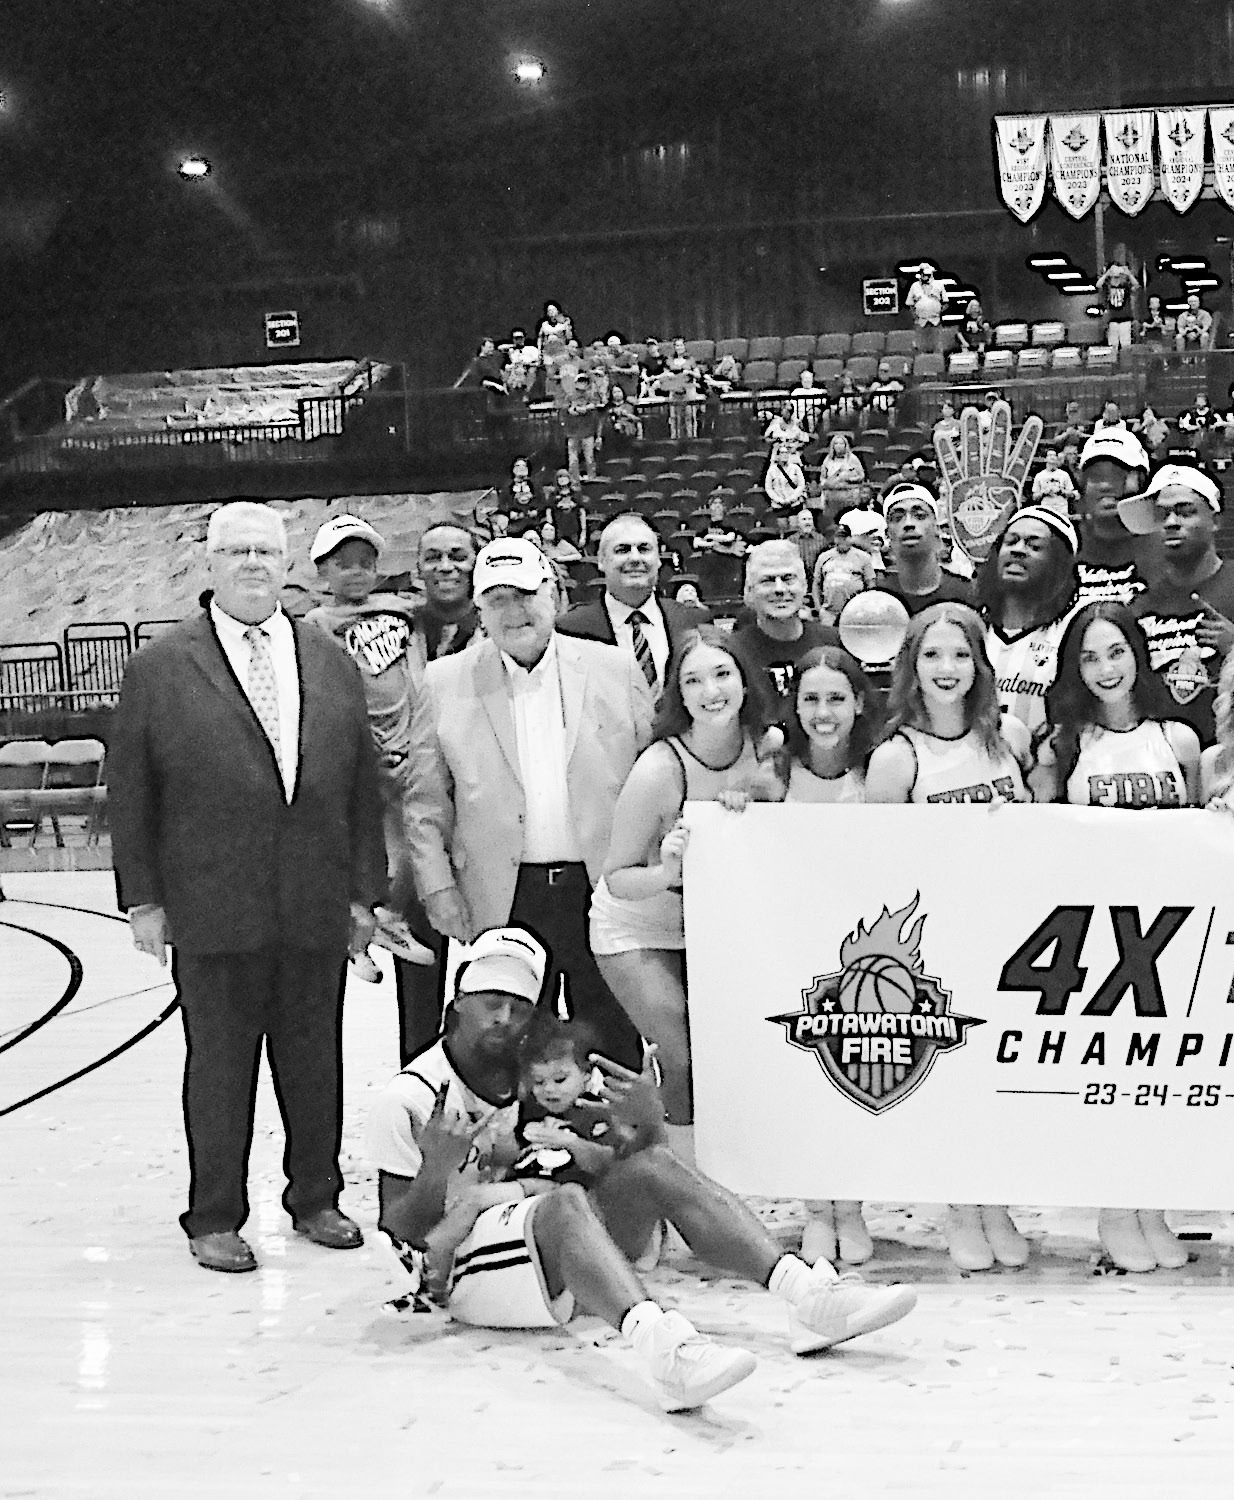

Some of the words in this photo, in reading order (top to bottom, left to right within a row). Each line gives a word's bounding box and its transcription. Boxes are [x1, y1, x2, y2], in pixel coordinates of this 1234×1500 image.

[1109, 152, 1149, 164] NATIONAL
[1056, 169, 1098, 180] CHAMPIONS
[1109, 164, 1152, 176] CHAMPIONS
[1002, 171, 1046, 183] CHAMPIONS
[1121, 177, 1141, 186] 2023
[1171, 175, 1191, 184] 2024
[1014, 183, 1034, 192] 2023
[1067, 181, 1087, 190] 2023
[866, 287, 897, 295] SECTION
[873, 297, 890, 305] 202
[275, 329, 290, 338] 201
[1087, 771, 1180, 807] FIRE
[996, 905, 1195, 1017] 4X
[796, 1013, 957, 1041] POTAWATOMI
[842, 1037, 912, 1065] FIRE
